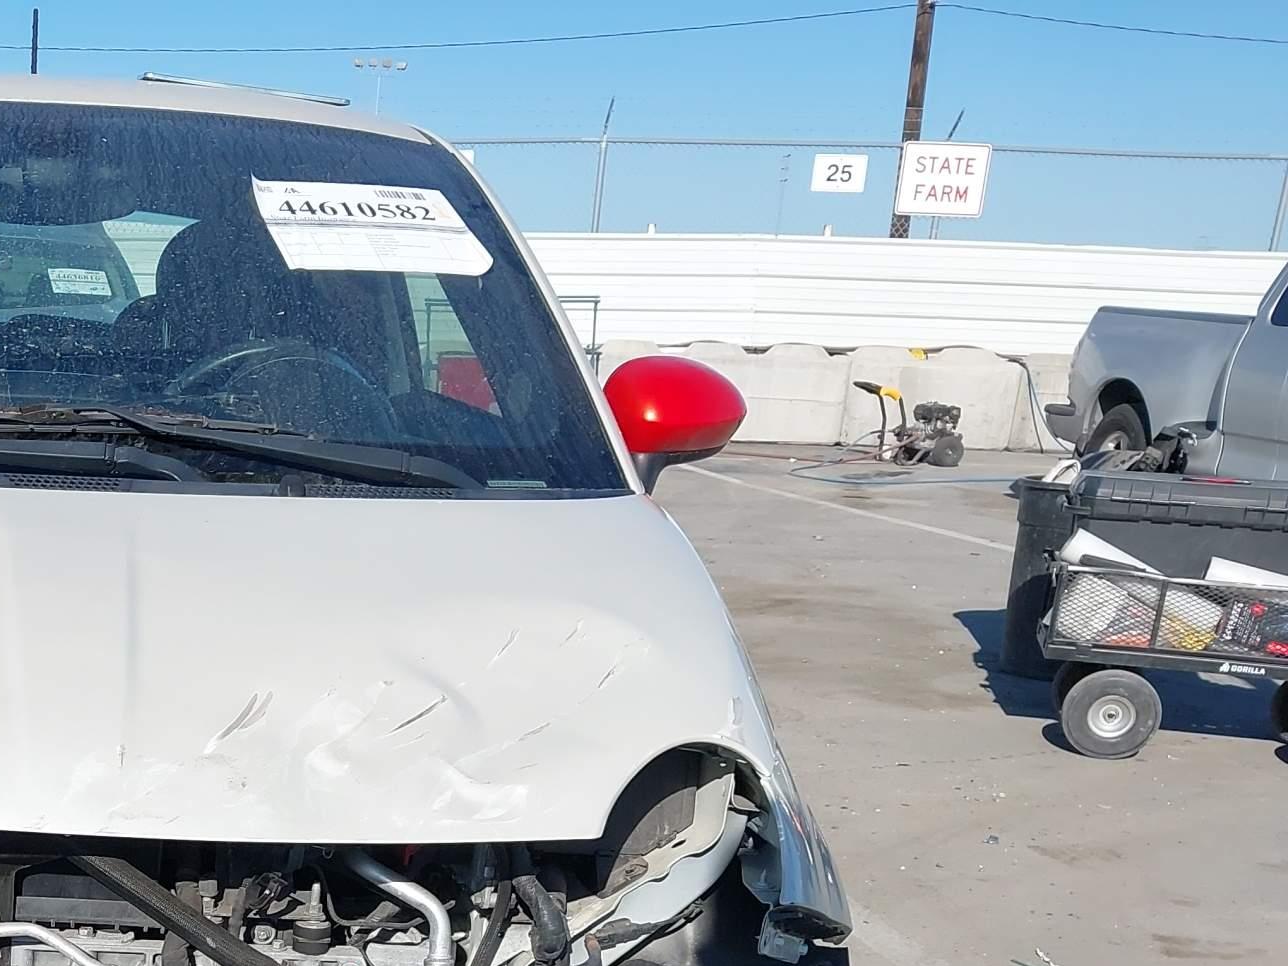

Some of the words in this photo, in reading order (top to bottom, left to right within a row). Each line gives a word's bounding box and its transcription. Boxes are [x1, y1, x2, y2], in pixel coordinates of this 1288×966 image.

[826, 163, 854, 183] 25
[915, 156, 977, 175] STATE
[913, 184, 969, 203] FARM
[278, 200, 437, 221] 44610582
[1230, 665, 1265, 675] GORILLA
